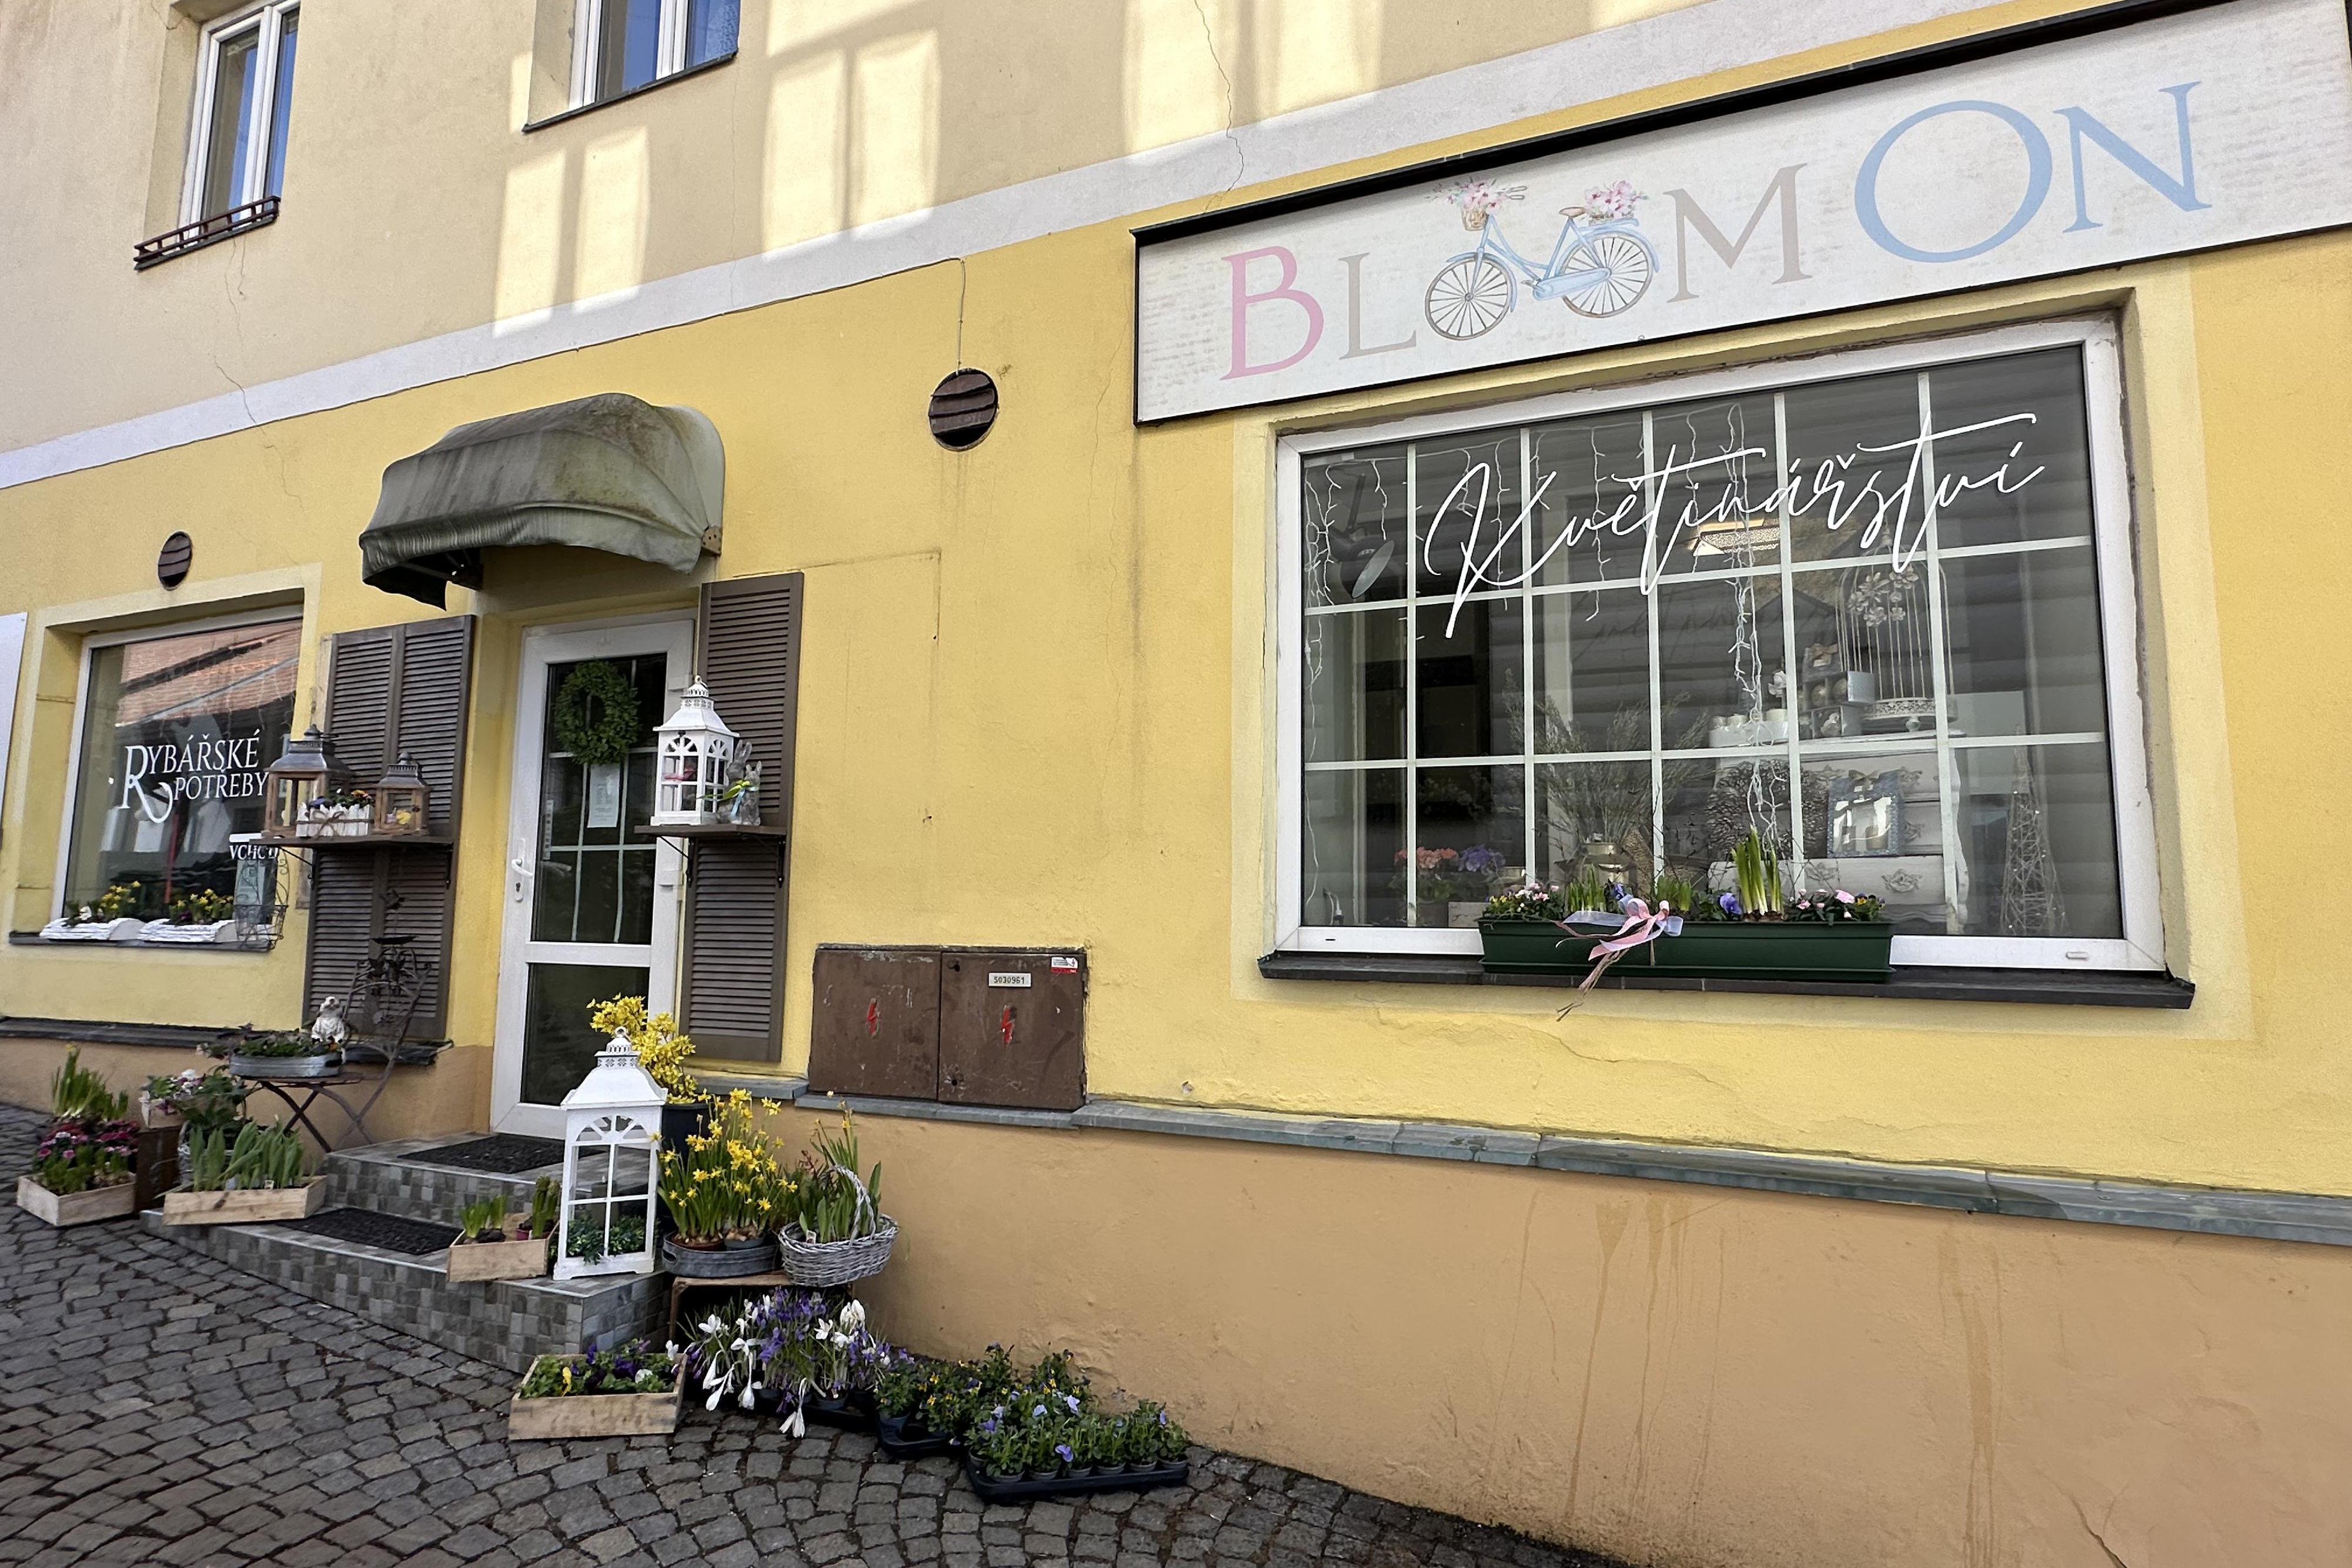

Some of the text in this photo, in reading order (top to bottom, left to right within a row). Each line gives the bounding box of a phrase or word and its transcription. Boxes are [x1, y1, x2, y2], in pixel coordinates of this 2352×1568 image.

[1424, 413, 2045, 638] Květinářství
[119, 729, 260, 823] RYBÁŘSKÉ
[175, 767, 269, 800] POTŘEBY
